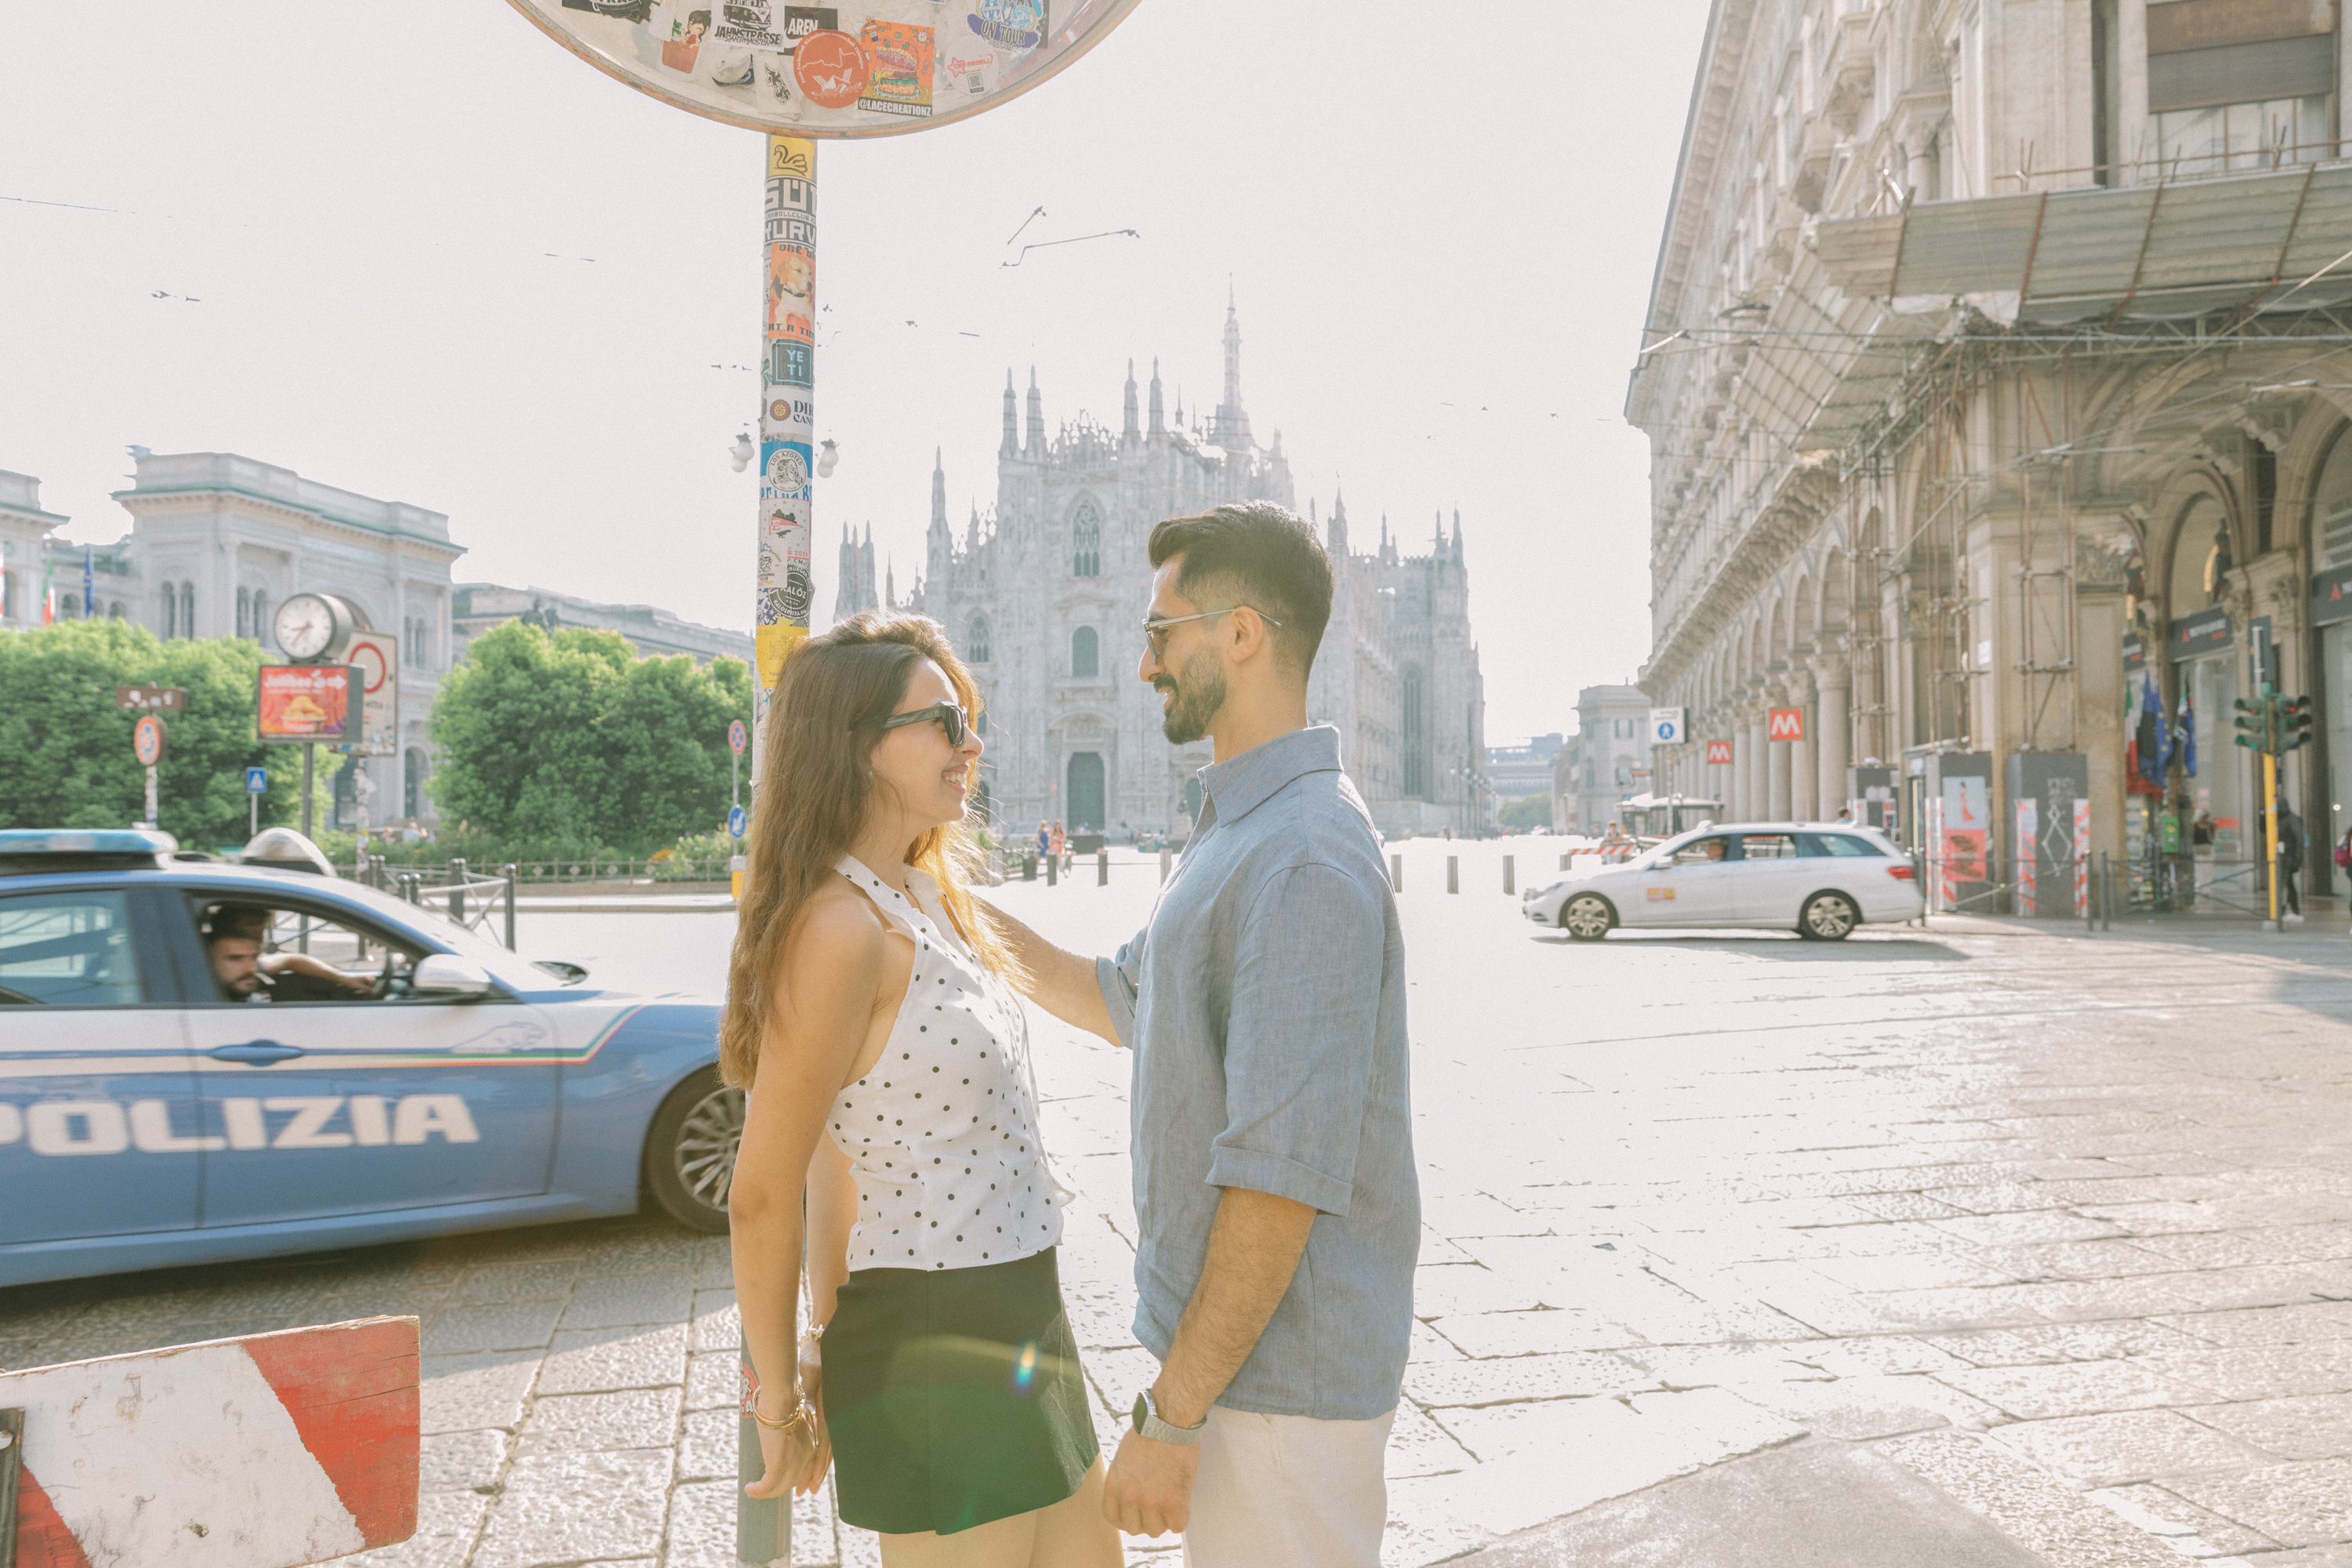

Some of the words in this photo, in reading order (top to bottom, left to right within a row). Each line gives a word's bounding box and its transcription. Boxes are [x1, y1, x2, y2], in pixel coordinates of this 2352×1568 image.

[714, 26, 782, 45] JAHNSTRASSE
[982, 20, 996, 39] ON
[1000, 25, 1025, 45] TOUR
[858, 99, 931, 116] @LACECREATIONZ
[786, 349, 804, 363] YE
[787, 364, 802, 377] TI
[771, 455, 781, 466] LOS
[781, 452, 803, 466] AZOTES
[772, 520, 781, 531] E
[1770, 713, 1801, 735] M
[1708, 744, 1730, 760] M
[0, 1094, 480, 1156] OLIZIA
